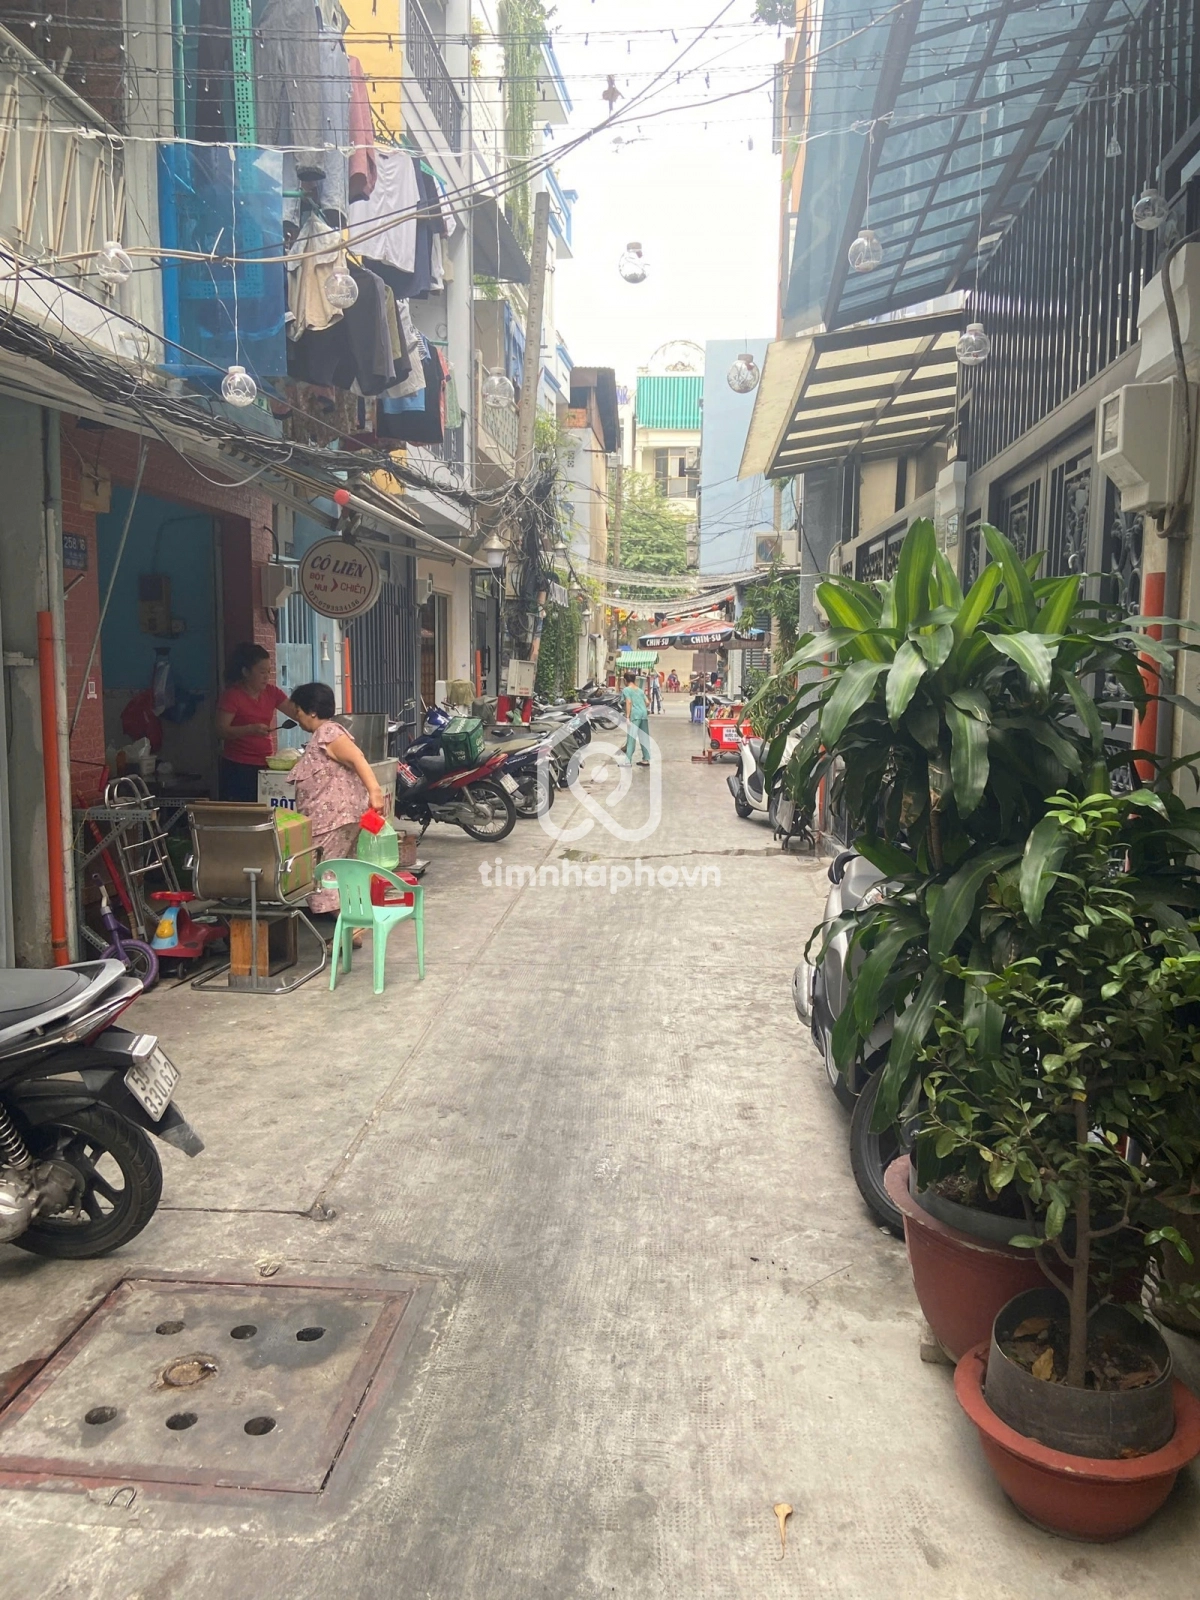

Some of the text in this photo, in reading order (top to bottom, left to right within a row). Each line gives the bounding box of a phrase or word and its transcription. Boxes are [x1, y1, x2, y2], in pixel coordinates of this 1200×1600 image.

[311, 554, 367, 577] CÔ LIÊN
[646, 638, 669, 646] CHIN-SU
[691, 634, 721, 644] CHIN-SU
[144, 1062, 178, 1114] 330.62
